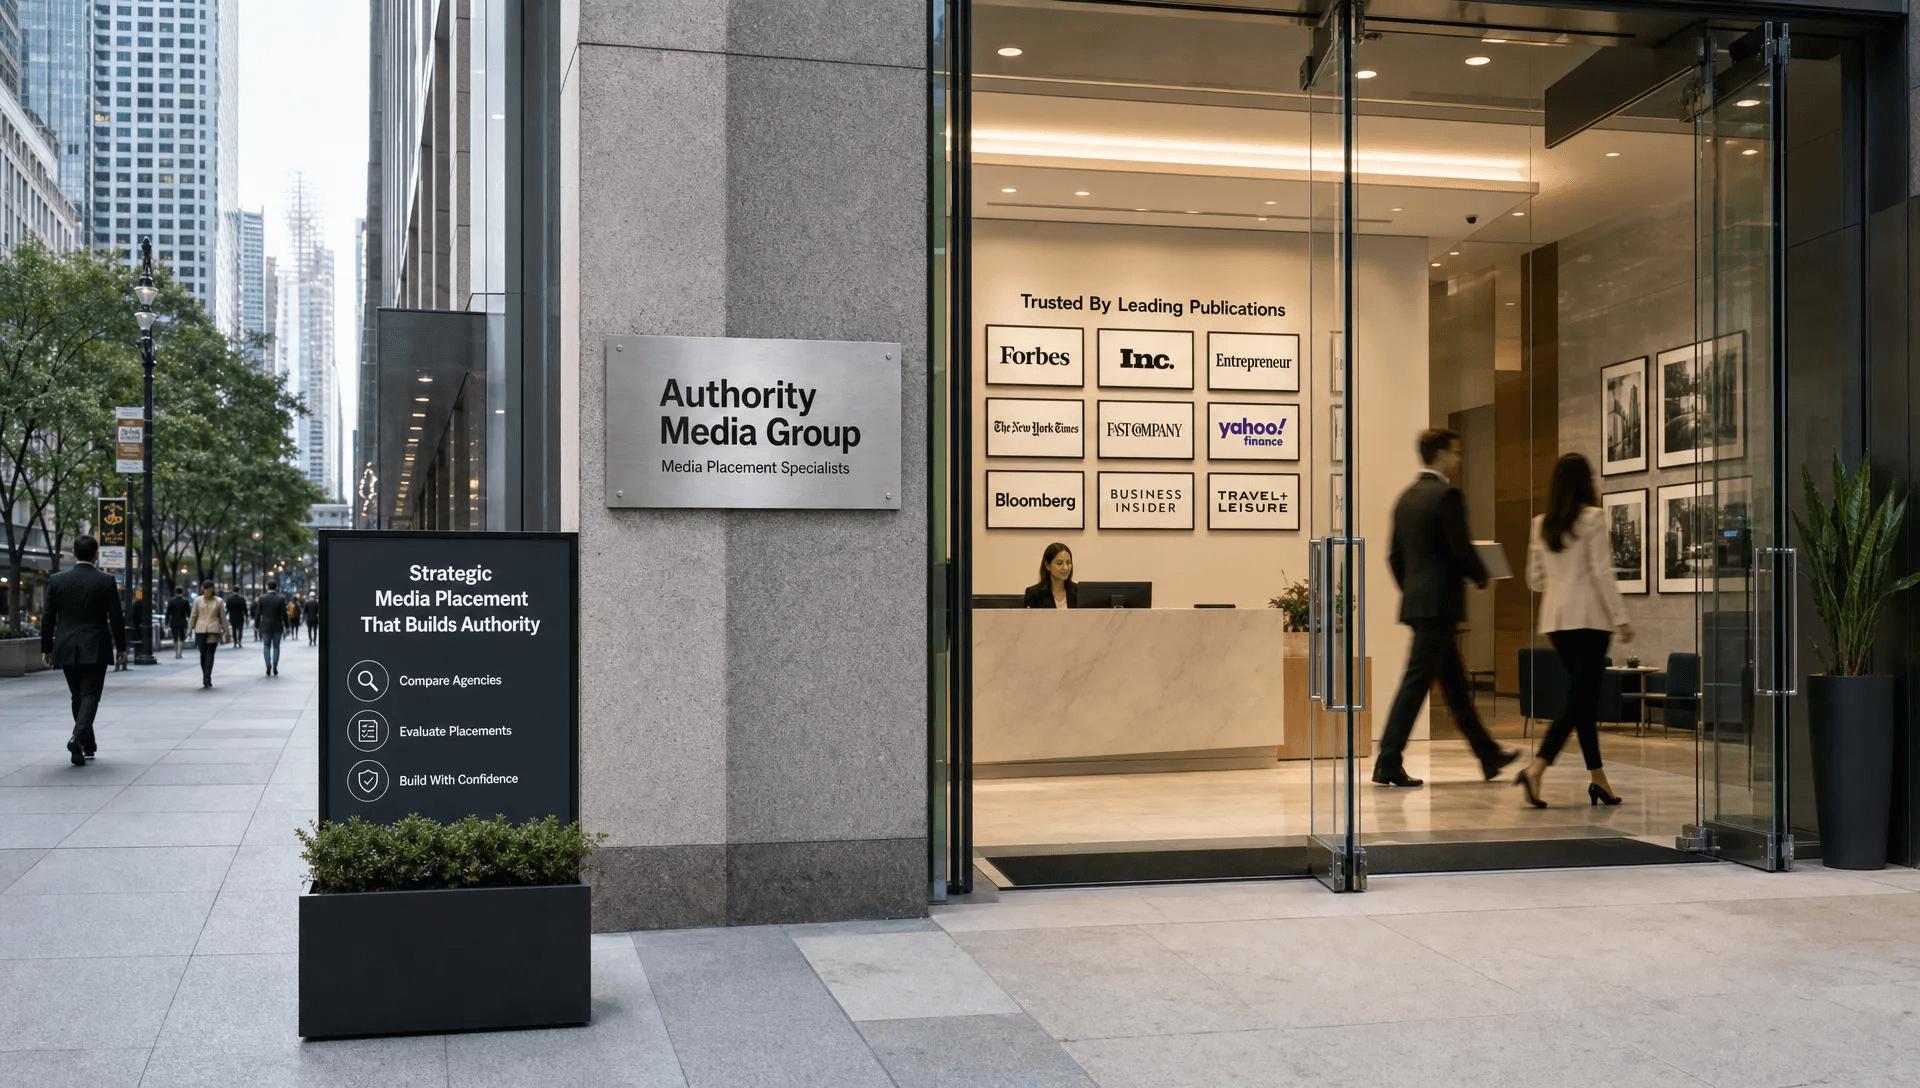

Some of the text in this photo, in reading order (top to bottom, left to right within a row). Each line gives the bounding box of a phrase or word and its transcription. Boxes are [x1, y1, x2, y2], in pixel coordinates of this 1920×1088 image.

[1021, 294, 1285, 317] Trusted By Leading Publications
[1000, 346, 1070, 365] Forbes
[1120, 349, 1174, 369] Inc.
[1216, 354, 1292, 372] Entrepreneur
[659, 379, 816, 416] Authority
[661, 416, 861, 454] Media Group
[994, 420, 1079, 436] The New York Times
[1107, 422, 1130, 436] FAST
[1219, 418, 1287, 439] yahoo!
[1244, 436, 1283, 446] finance
[662, 460, 849, 476] Media Placement Specialists
[996, 493, 1075, 511] Bloomberg
[1111, 489, 1181, 499] BUSINESS
[1218, 491, 1287, 500] TRAVEL+
[1116, 503, 1175, 512] INSIDER
[1219, 503, 1287, 512] LEISURE
[410, 565, 492, 585] Strategic
[376, 590, 528, 606] Media Placement
[361, 616, 540, 635] That Builds Authority
[400, 675, 501, 688] Compare Agencies
[400, 726, 512, 736] Evaluate Placements
[400, 774, 518, 786] Build With Confidence
